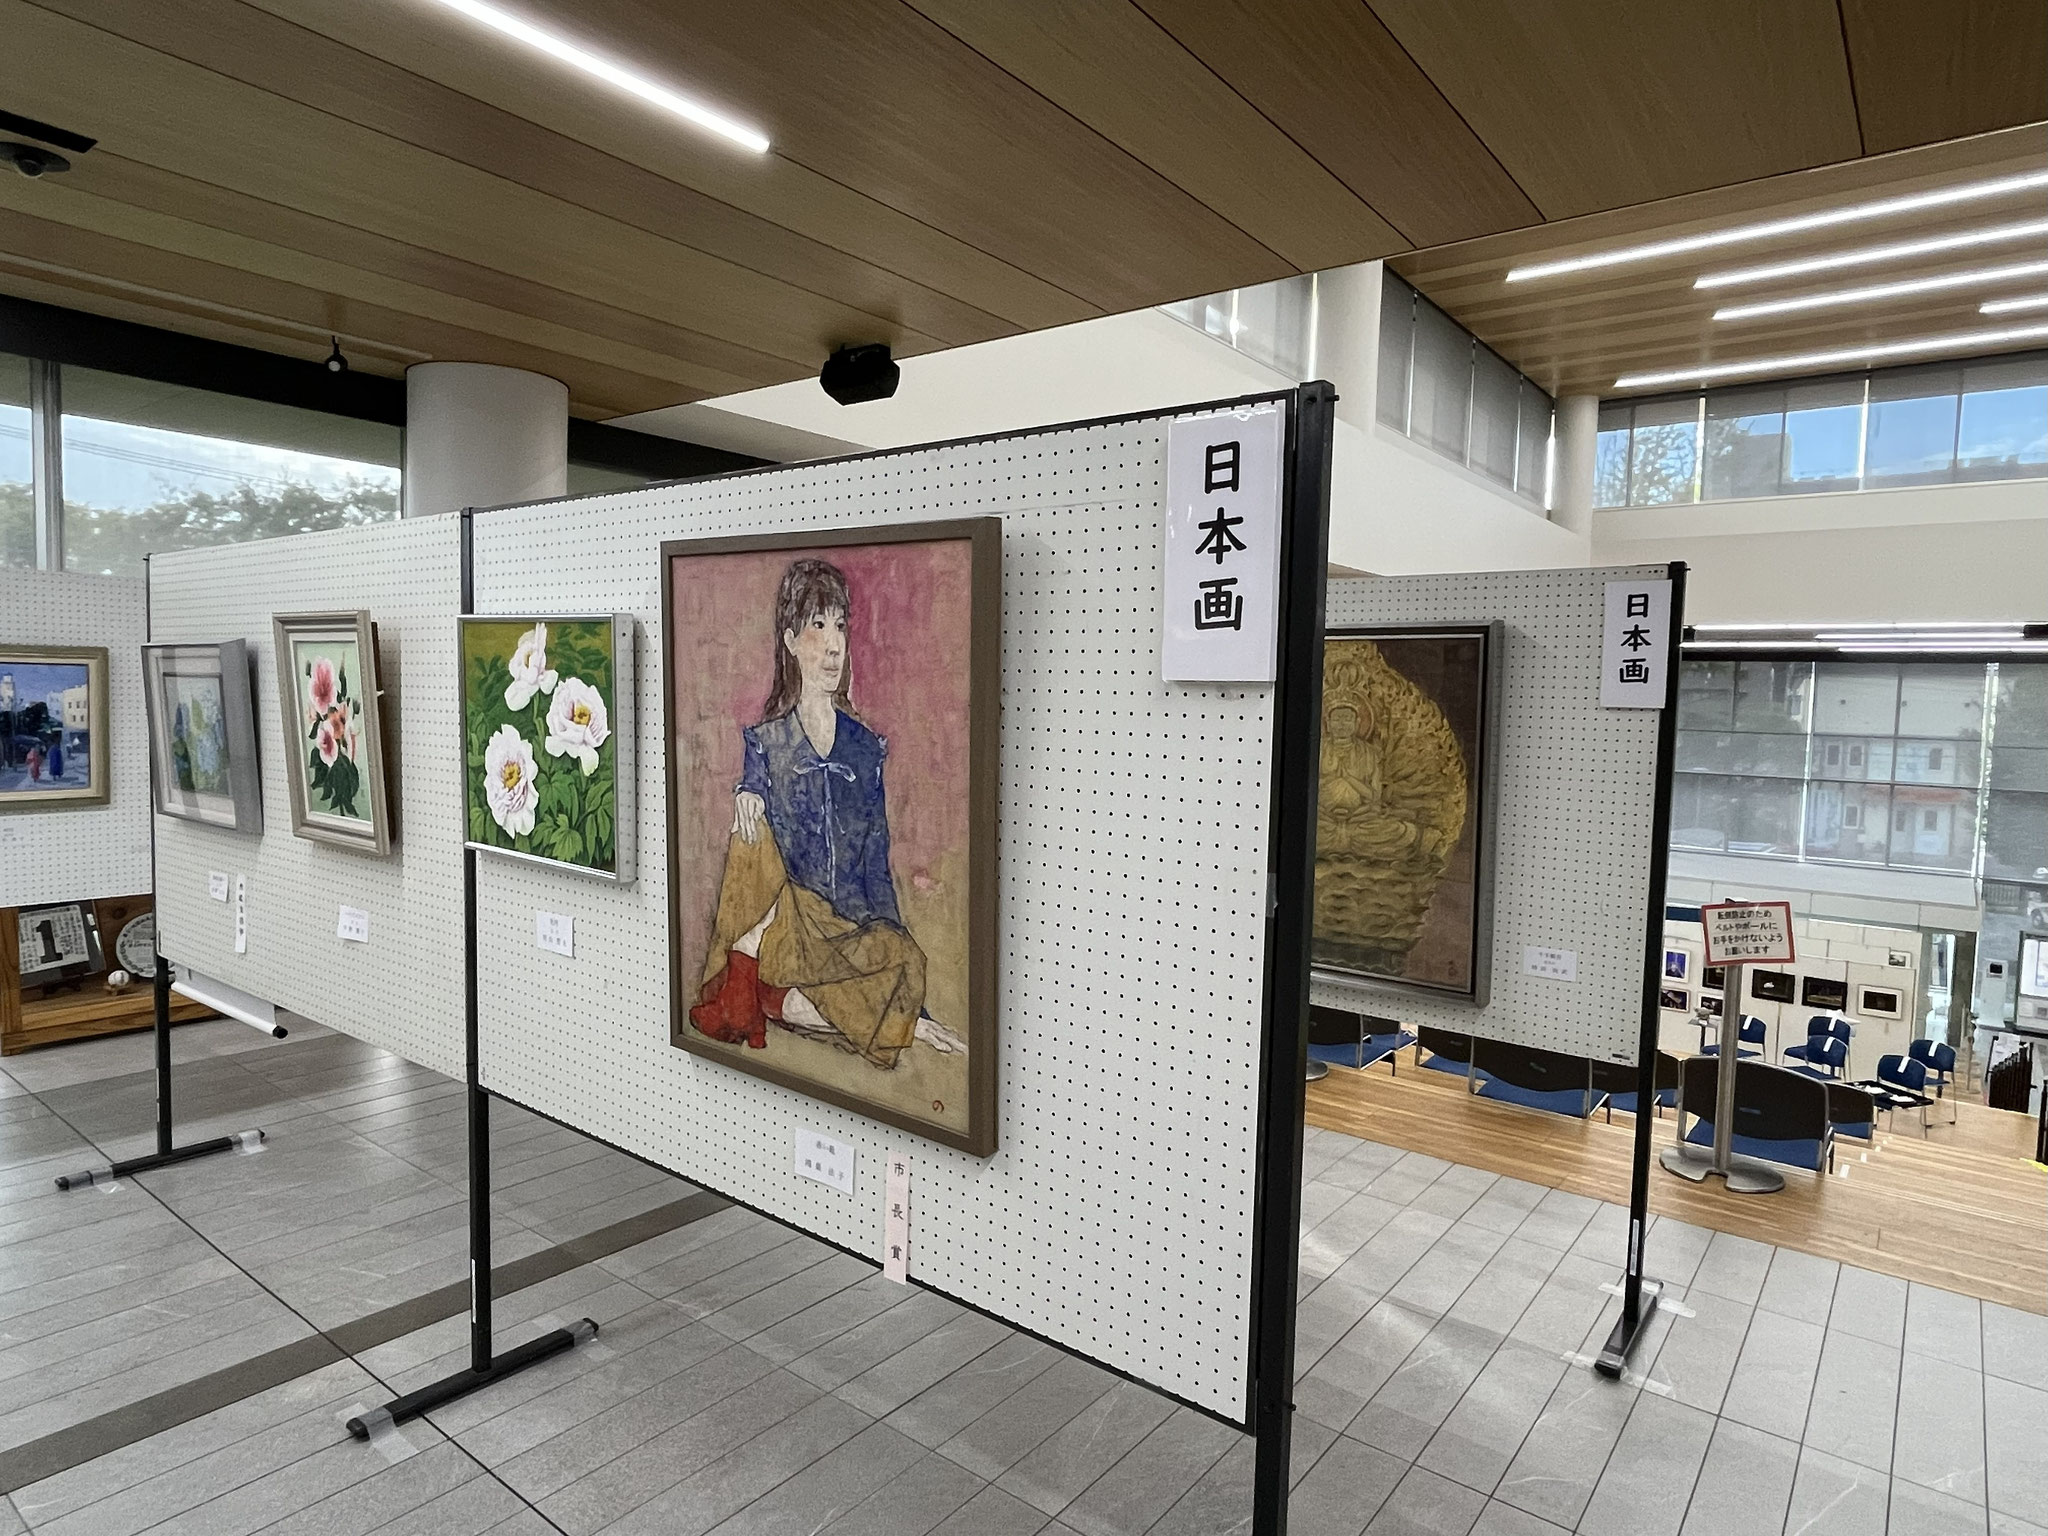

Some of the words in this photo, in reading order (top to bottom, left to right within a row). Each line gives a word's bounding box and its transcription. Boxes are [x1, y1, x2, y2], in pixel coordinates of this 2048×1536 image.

[1195, 440, 1247, 631] 日本画
[1619, 593, 1652, 684] 日本画
[35, 919, 63, 964] 1
[890, 1162, 905, 1262] 市長賞
